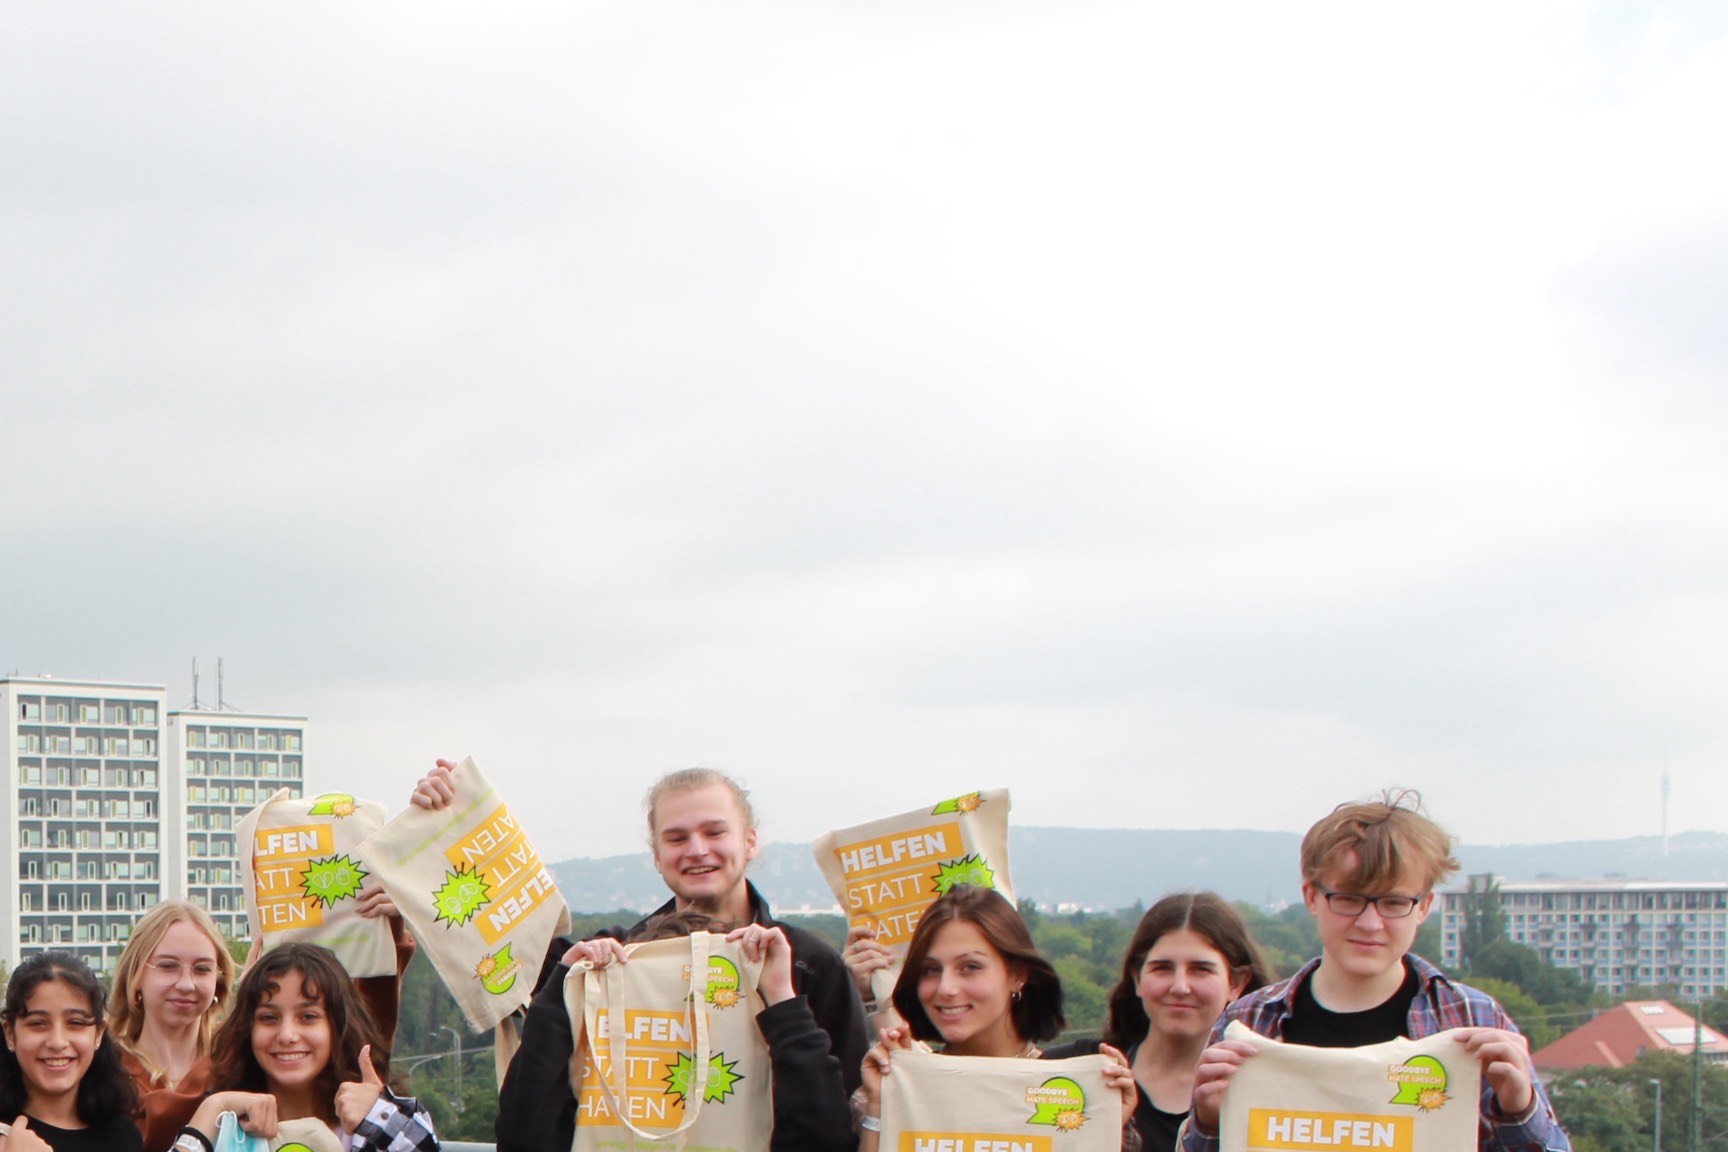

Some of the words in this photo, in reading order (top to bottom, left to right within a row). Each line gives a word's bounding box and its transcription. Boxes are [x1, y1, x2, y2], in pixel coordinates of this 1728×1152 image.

[840, 831, 946, 874] HELFEN
[849, 873, 923, 909] STATT
[1389, 1065, 1430, 1074] GOODBYE
[1388, 1074, 1410, 1083] HATE
[1411, 1075, 1442, 1084] SPEECH
[1027, 1087, 1067, 1095] GOODBYE
[1026, 1096, 1046, 1104] HATE
[1048, 1097, 1079, 1105] SPEECH
[1267, 1116, 1395, 1148] HELFEN
